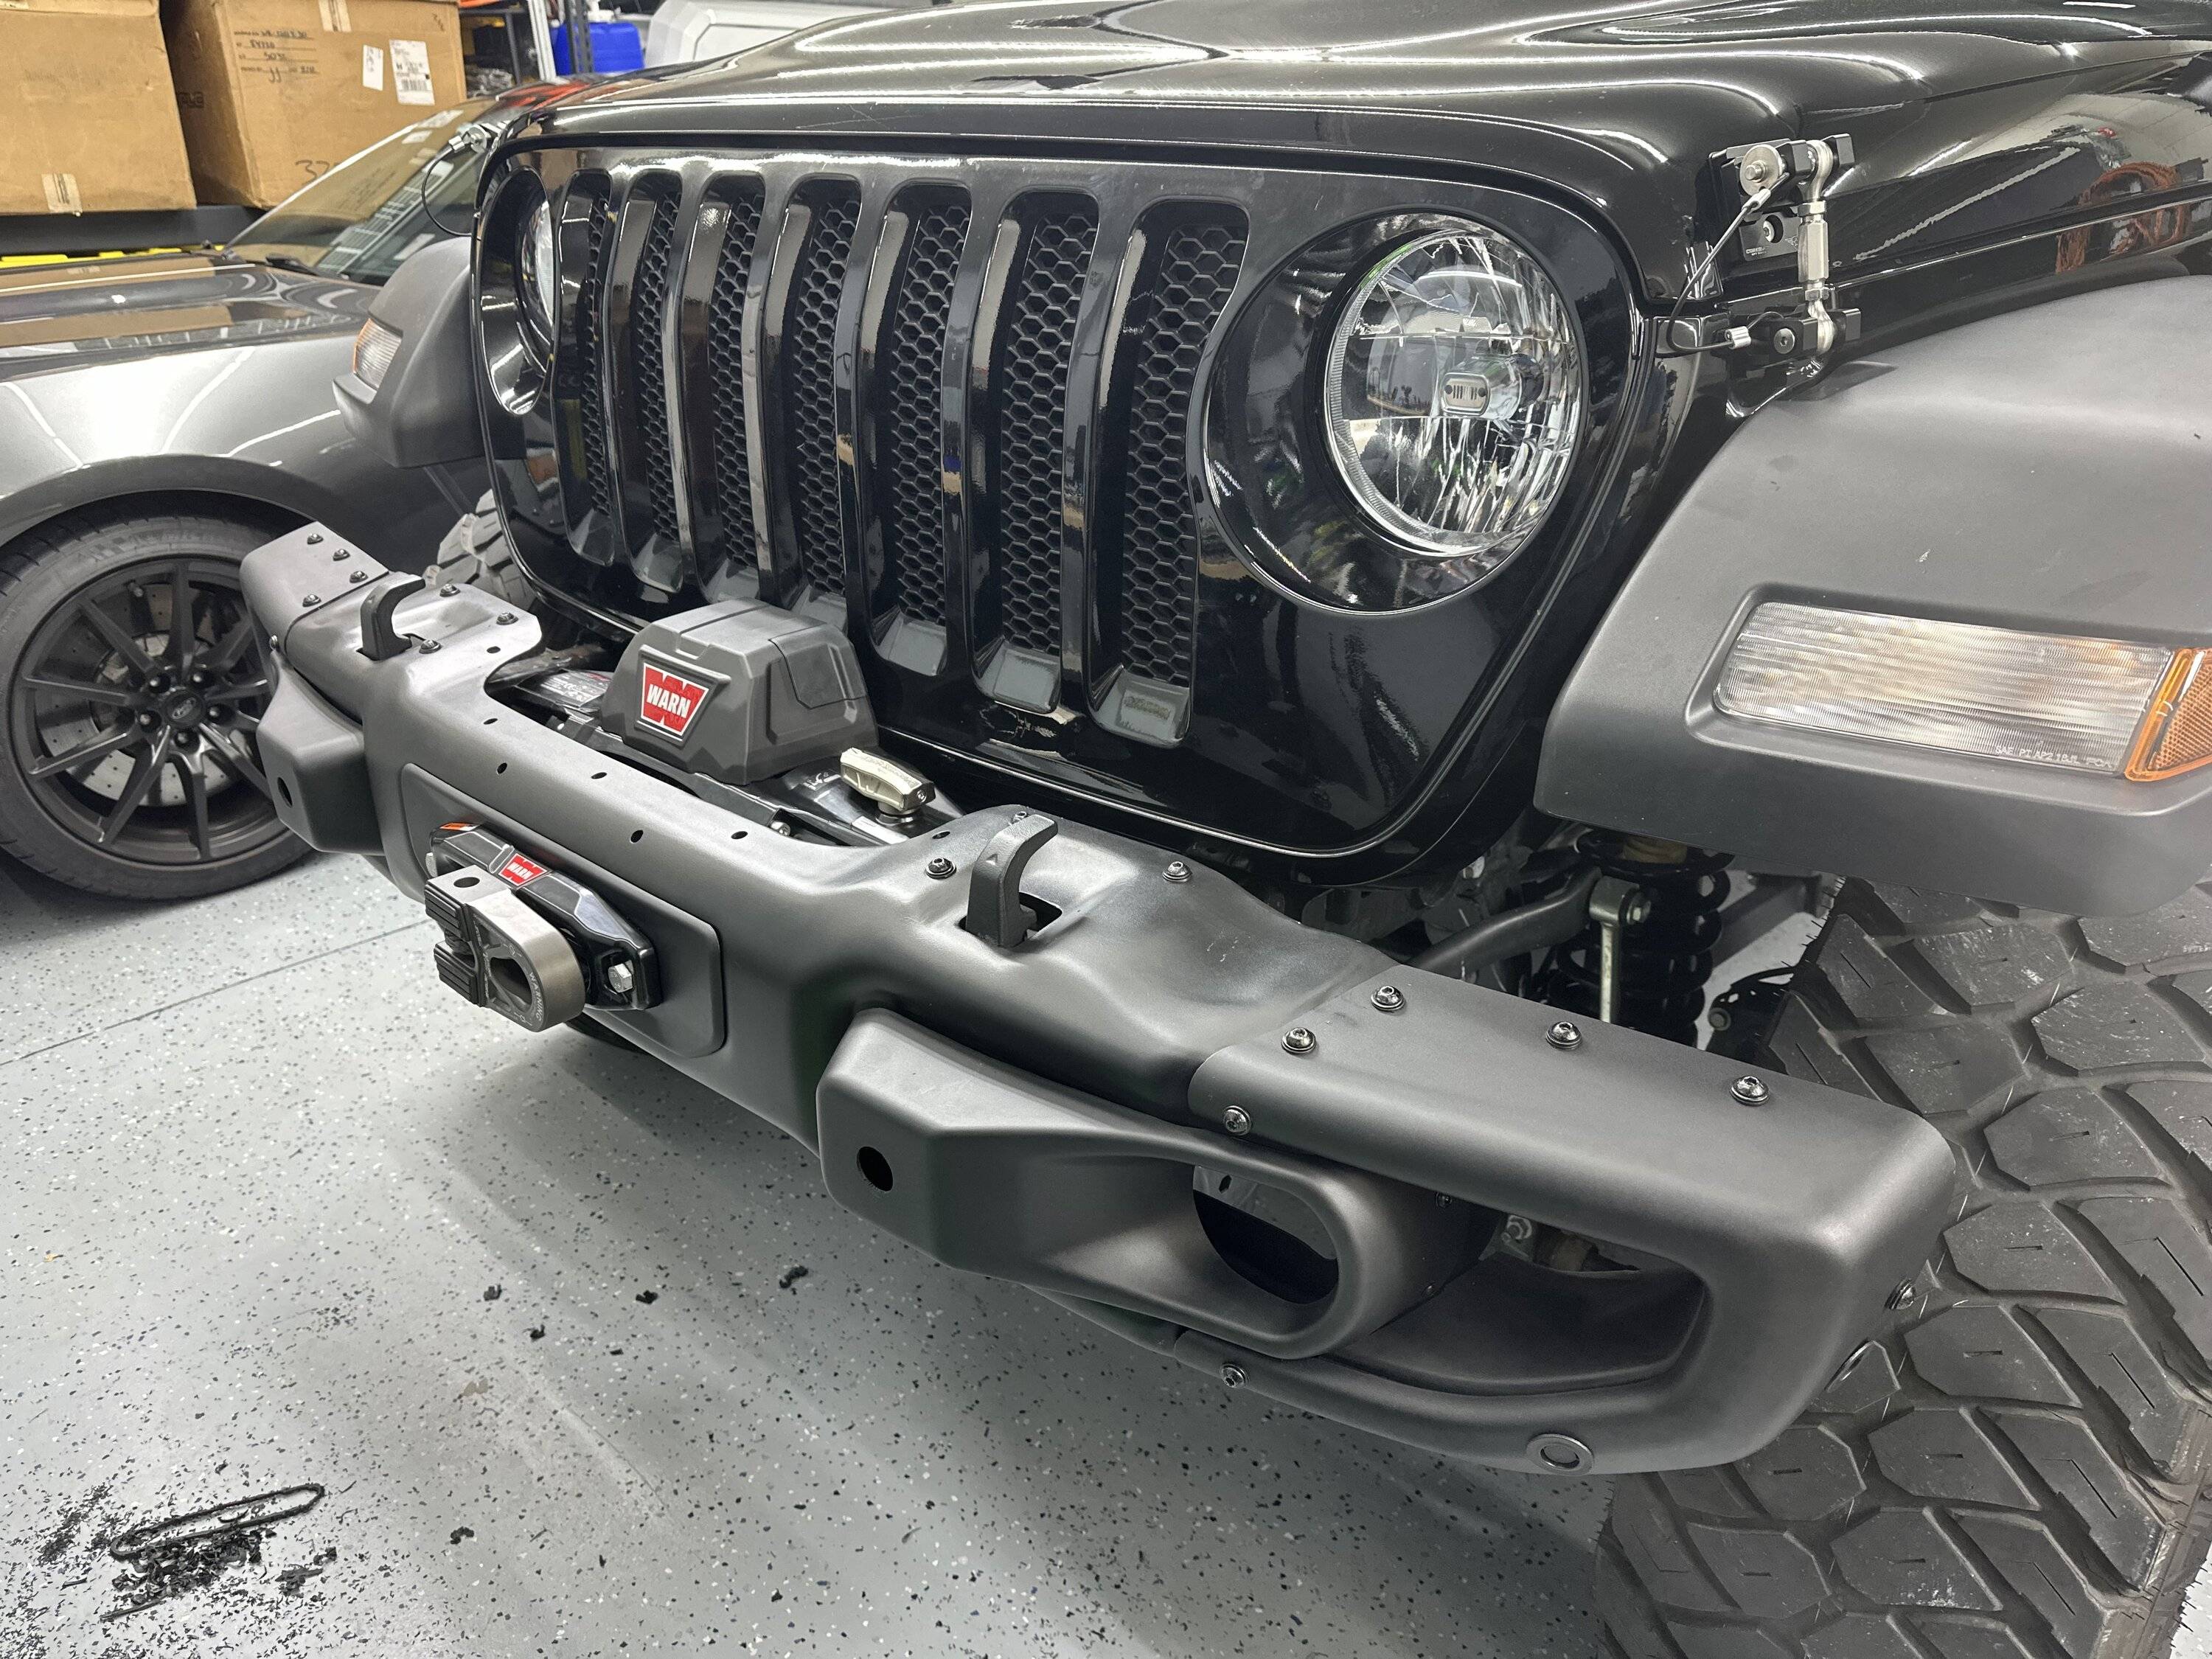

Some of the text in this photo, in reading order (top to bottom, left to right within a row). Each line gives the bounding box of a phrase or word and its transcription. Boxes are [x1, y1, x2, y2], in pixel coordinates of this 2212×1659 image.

[647, 684, 691, 718] WARN
[1995, 745, 2014, 756] SAE
[507, 862, 534, 880] WARN
[529, 972, 543, 1021] WARNING
